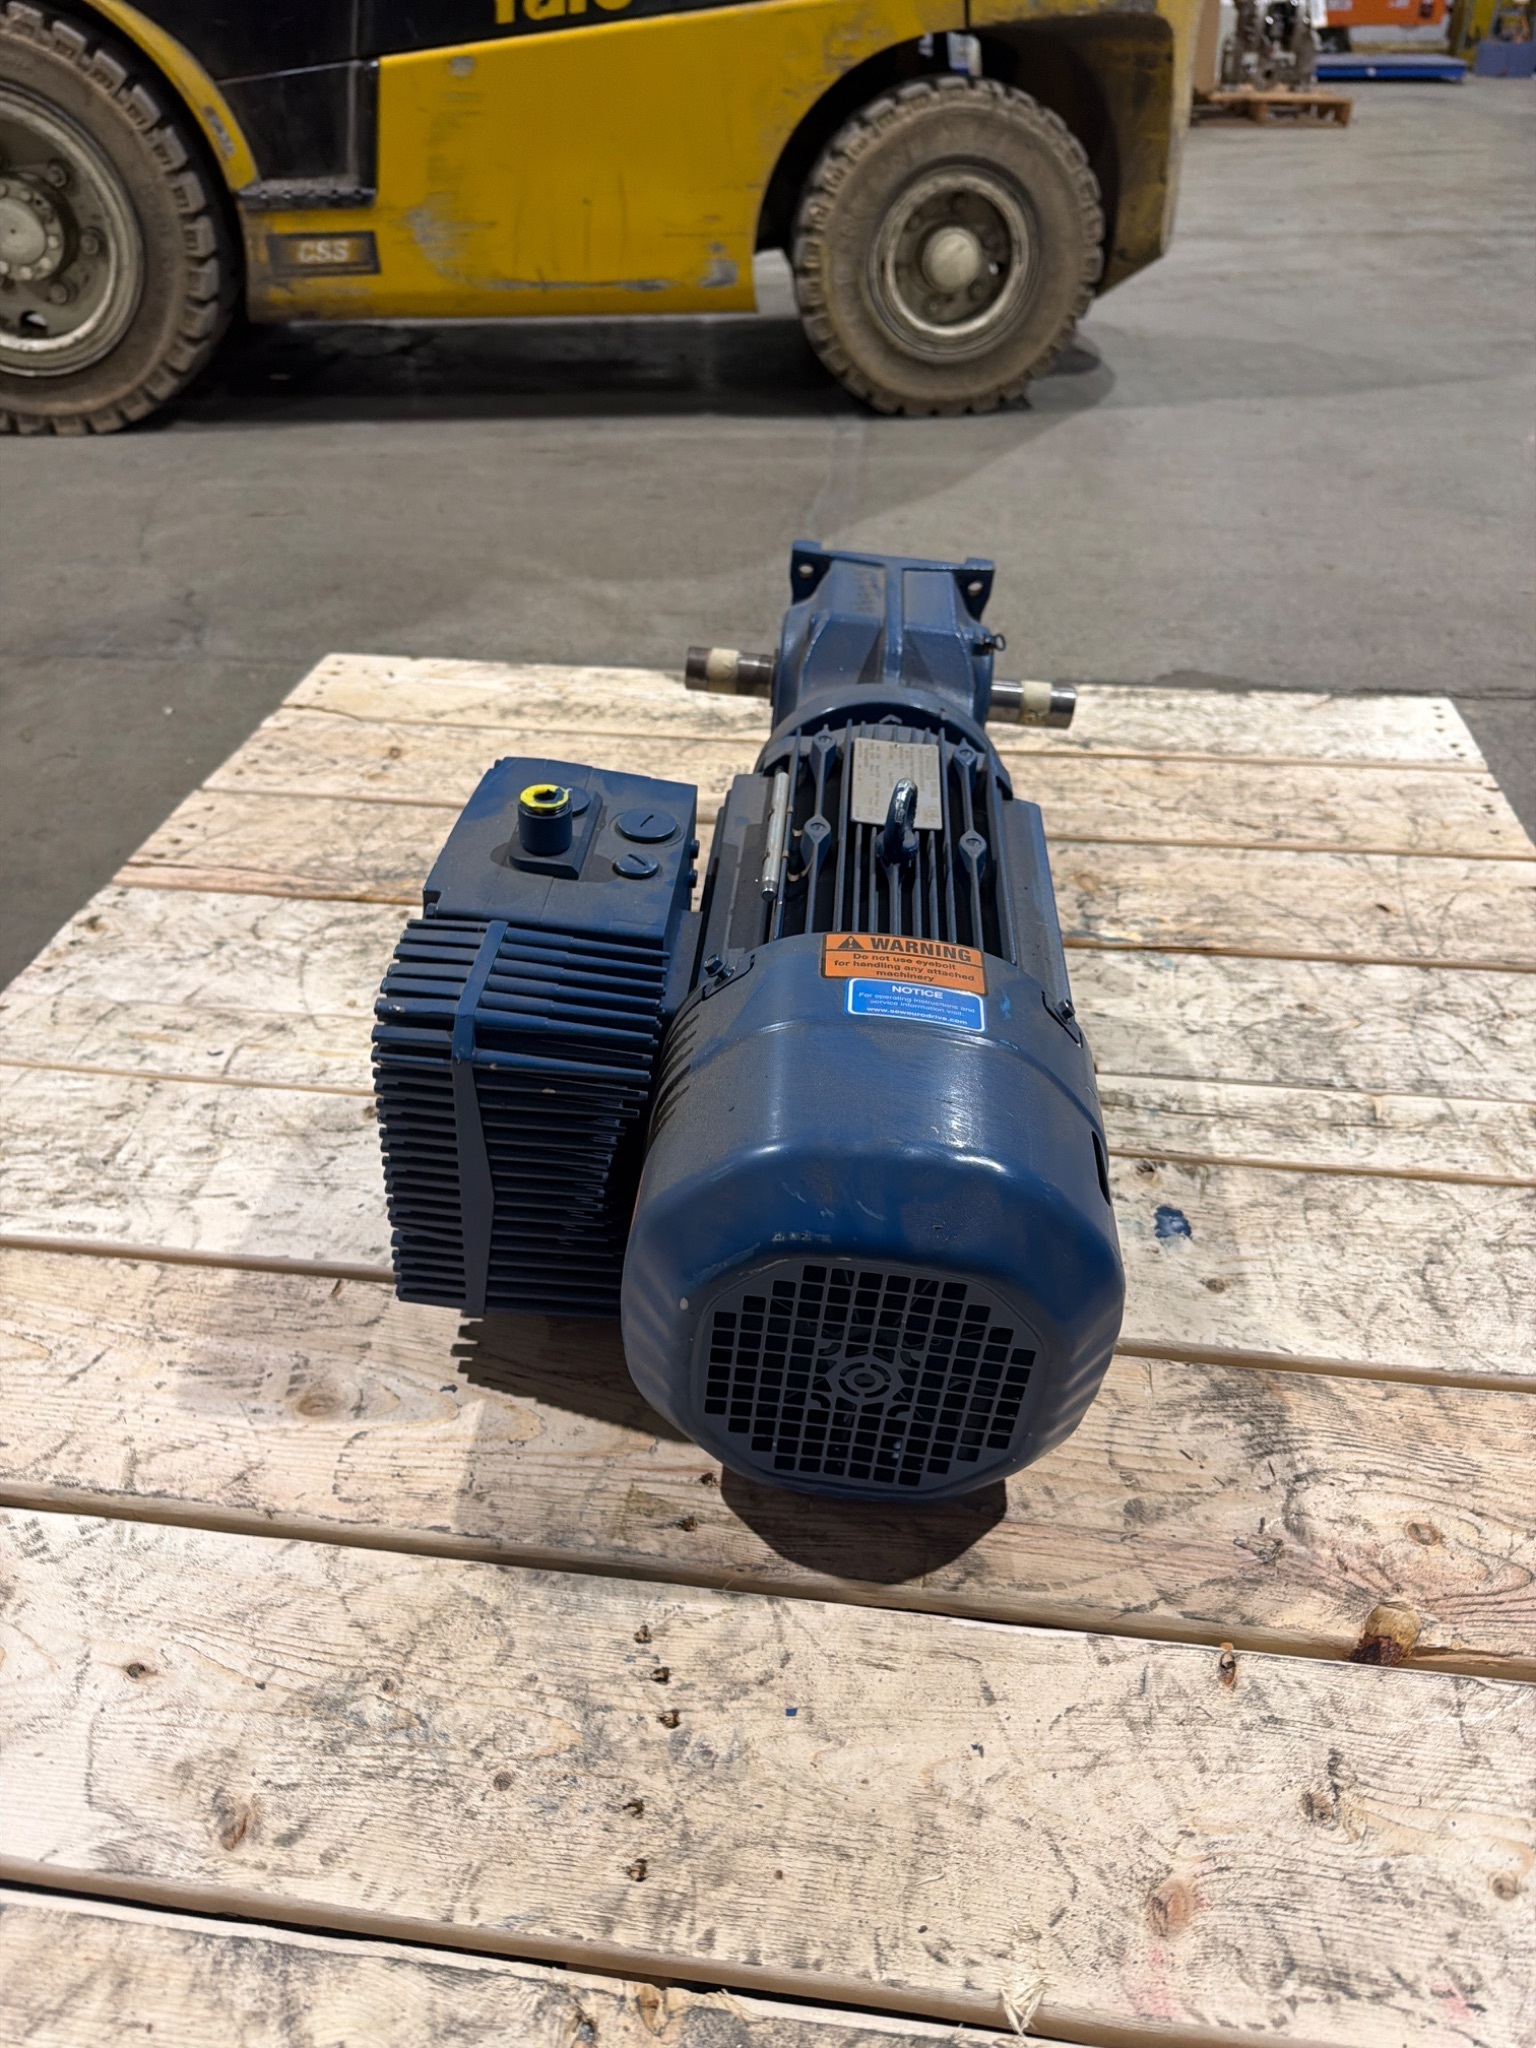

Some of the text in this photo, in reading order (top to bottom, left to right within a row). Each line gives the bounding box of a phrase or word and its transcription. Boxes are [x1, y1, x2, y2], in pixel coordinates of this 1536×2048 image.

[870, 937, 971, 962] WARNING
[853, 961, 901, 972] handling
[903, 965, 924, 974] any
[926, 968, 975, 981] attached
[871, 954, 890, 962] not
[915, 959, 957, 971] eyebolt
[876, 970, 935, 982] machinery
[891, 985, 944, 999] NOTICE
[869, 999, 899, 1007] service
[900, 1001, 945, 1013] information
[874, 994, 912, 1003] operating
[913, 997, 959, 1010] instructions
[960, 1006, 976, 1014] and
[866, 1007, 968, 1025] www.seweurodrive.com
